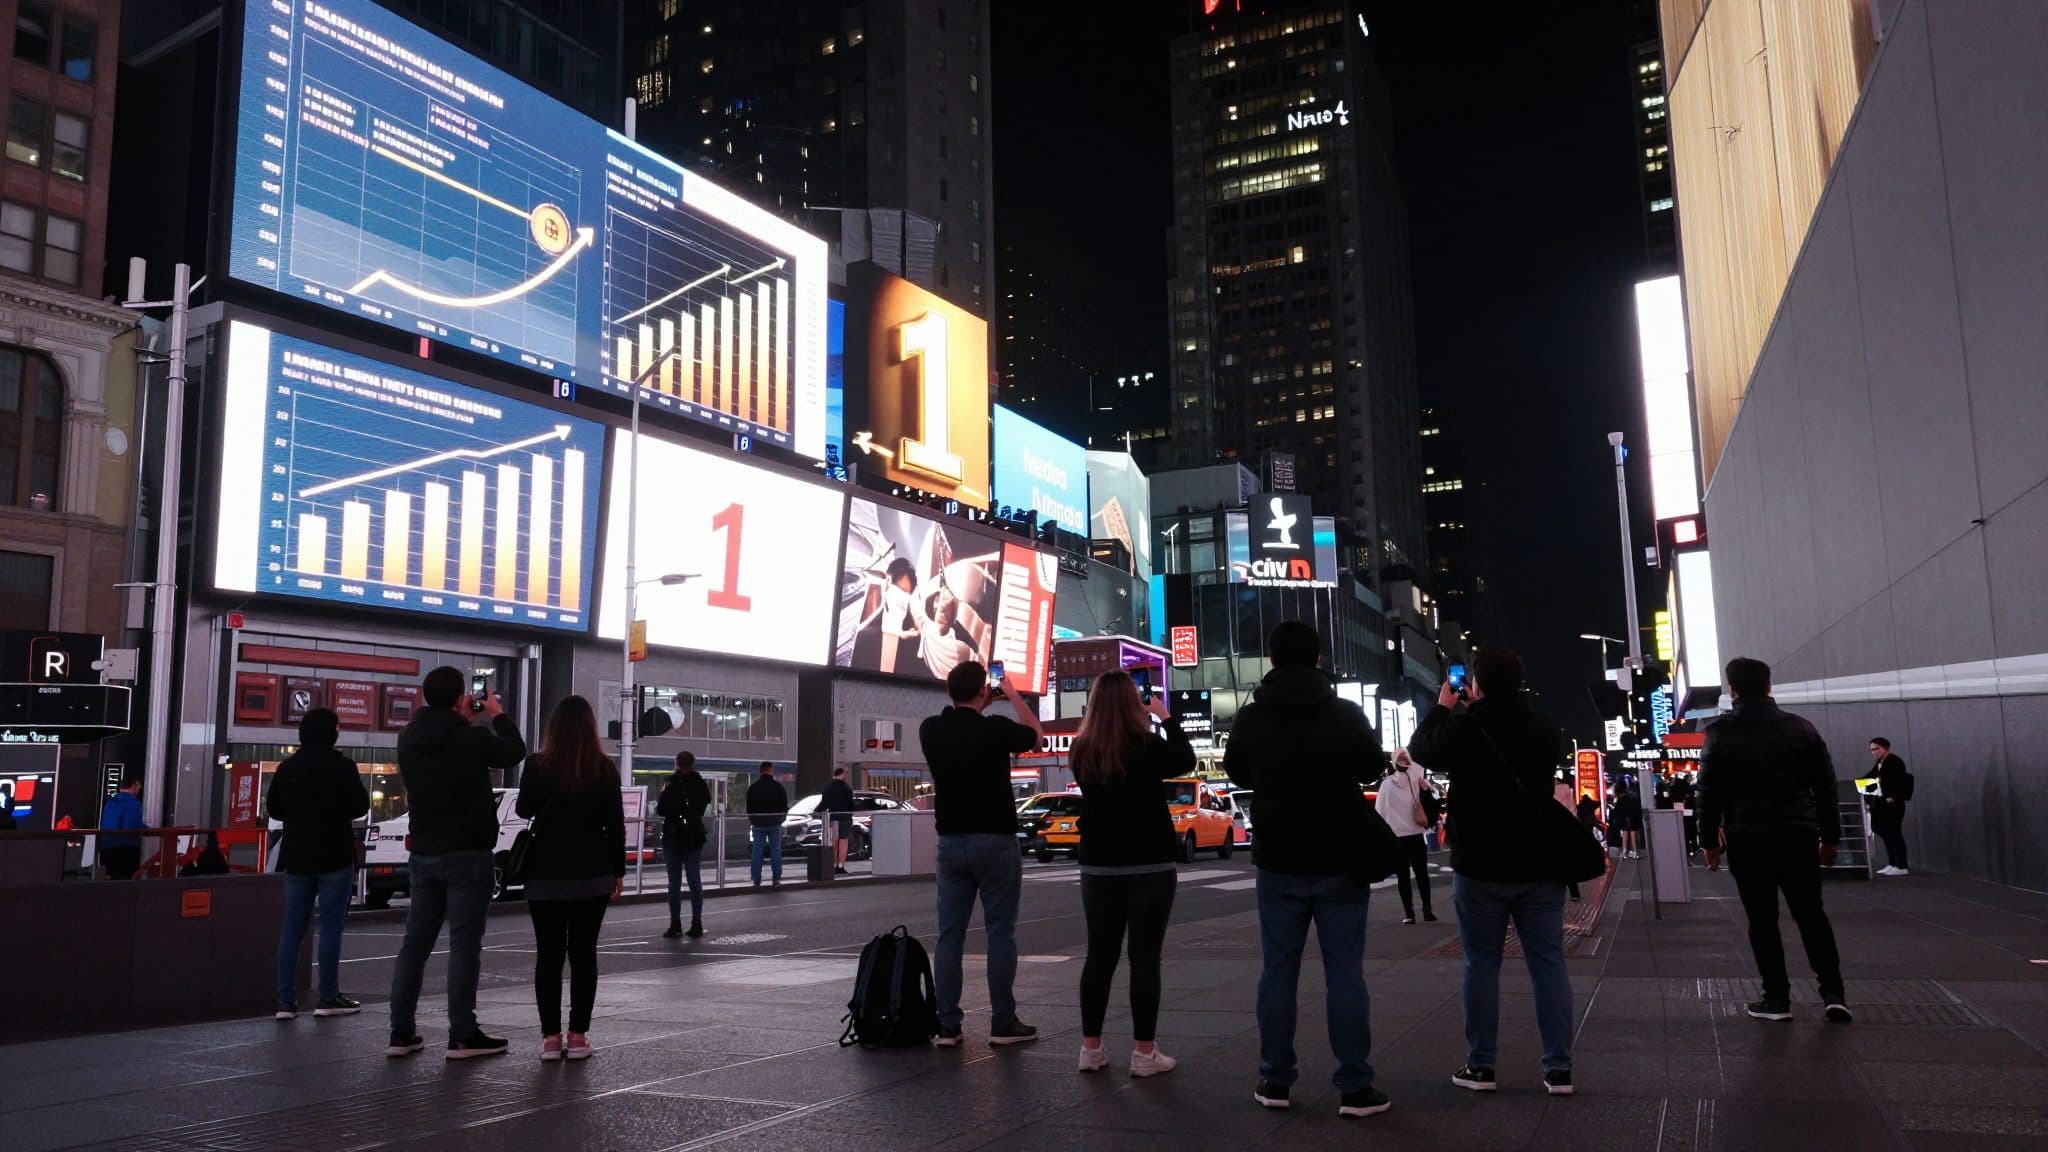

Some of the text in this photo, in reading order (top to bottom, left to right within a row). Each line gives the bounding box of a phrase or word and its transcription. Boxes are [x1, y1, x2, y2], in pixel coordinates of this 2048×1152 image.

[900, 310, 964, 485] 1
[707, 502, 751, 612] 1
[45, 651, 65, 677] R
